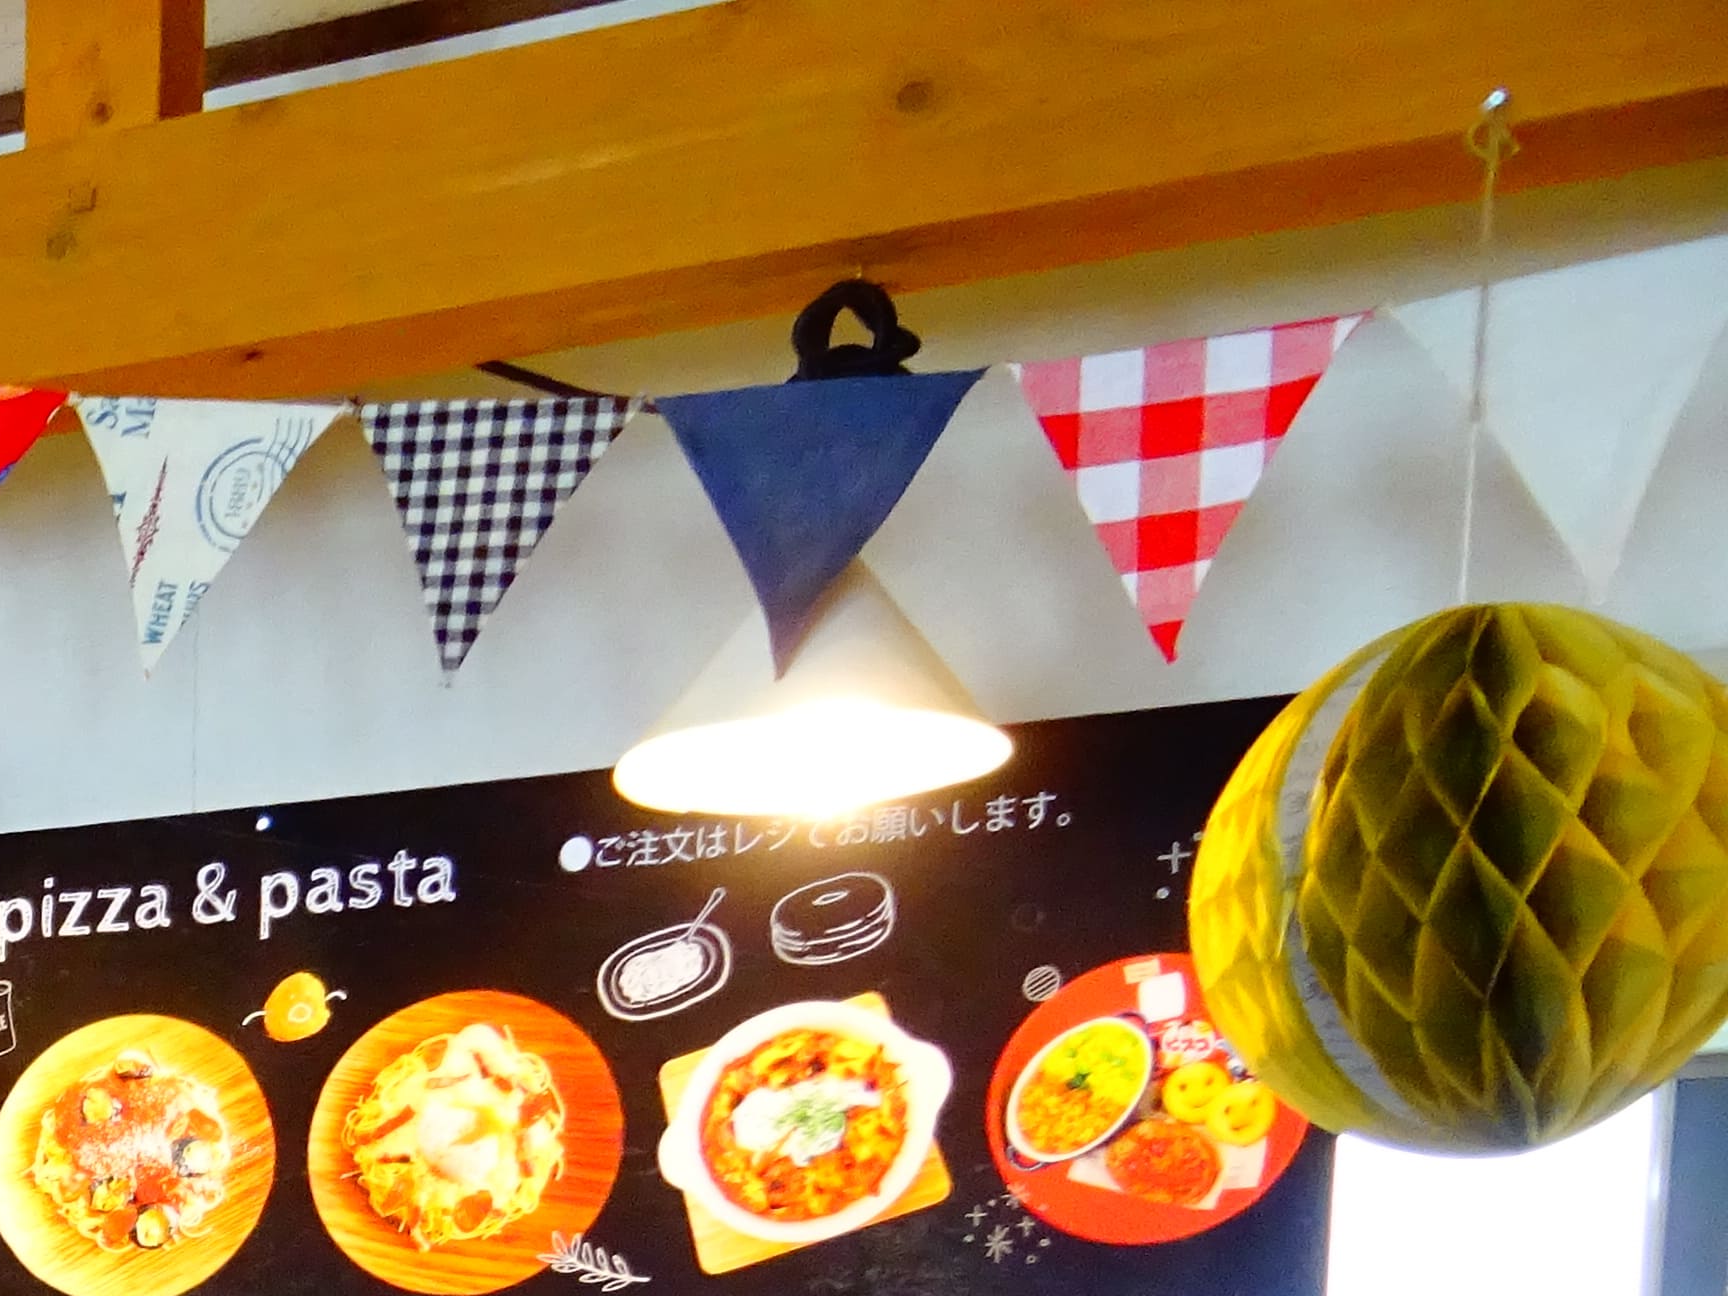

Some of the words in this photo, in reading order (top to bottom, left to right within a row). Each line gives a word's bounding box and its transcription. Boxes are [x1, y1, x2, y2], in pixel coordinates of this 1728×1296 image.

[142, 580, 179, 645] WHEAT
[190, 861, 239, 925] &
[258, 850, 458, 940] pasta
